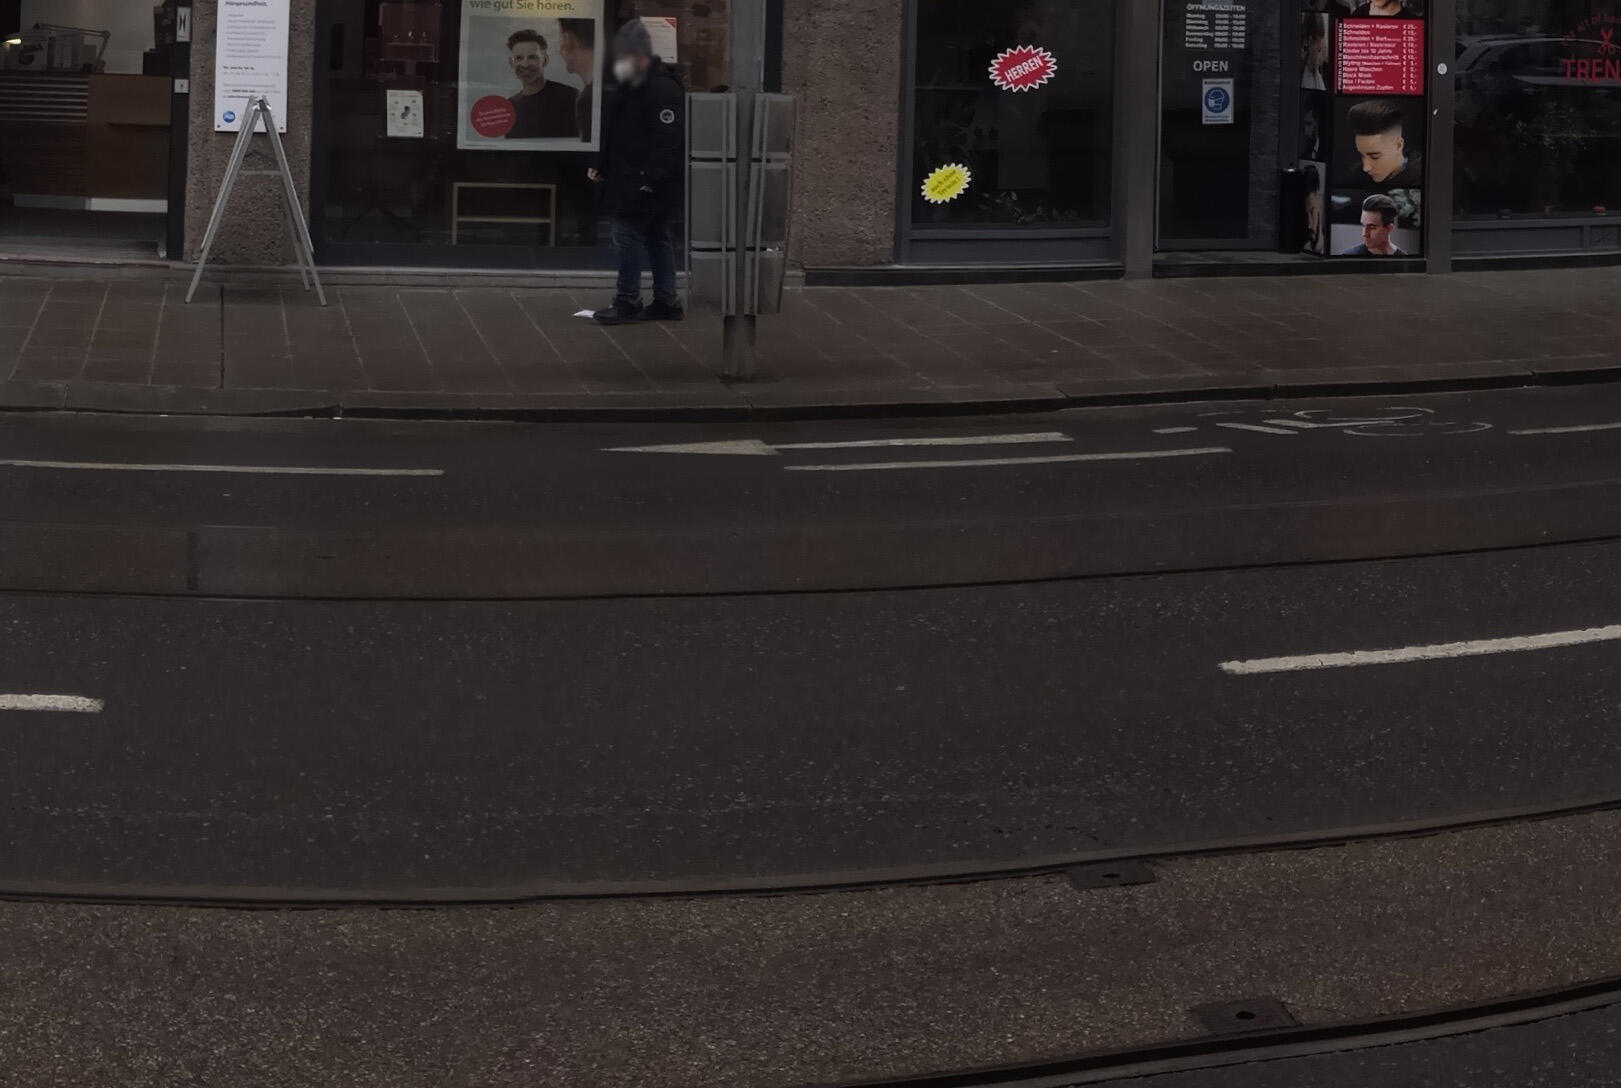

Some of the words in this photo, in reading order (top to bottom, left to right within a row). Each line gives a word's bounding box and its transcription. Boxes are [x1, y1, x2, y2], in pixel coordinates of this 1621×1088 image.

[470, 0, 491, 9] wie
[493, 0, 514, 12] gut
[516, 0, 534, 10] Sie
[1004, 55, 1044, 83] HERREN
[1192, 60, 1229, 72] OPEN
